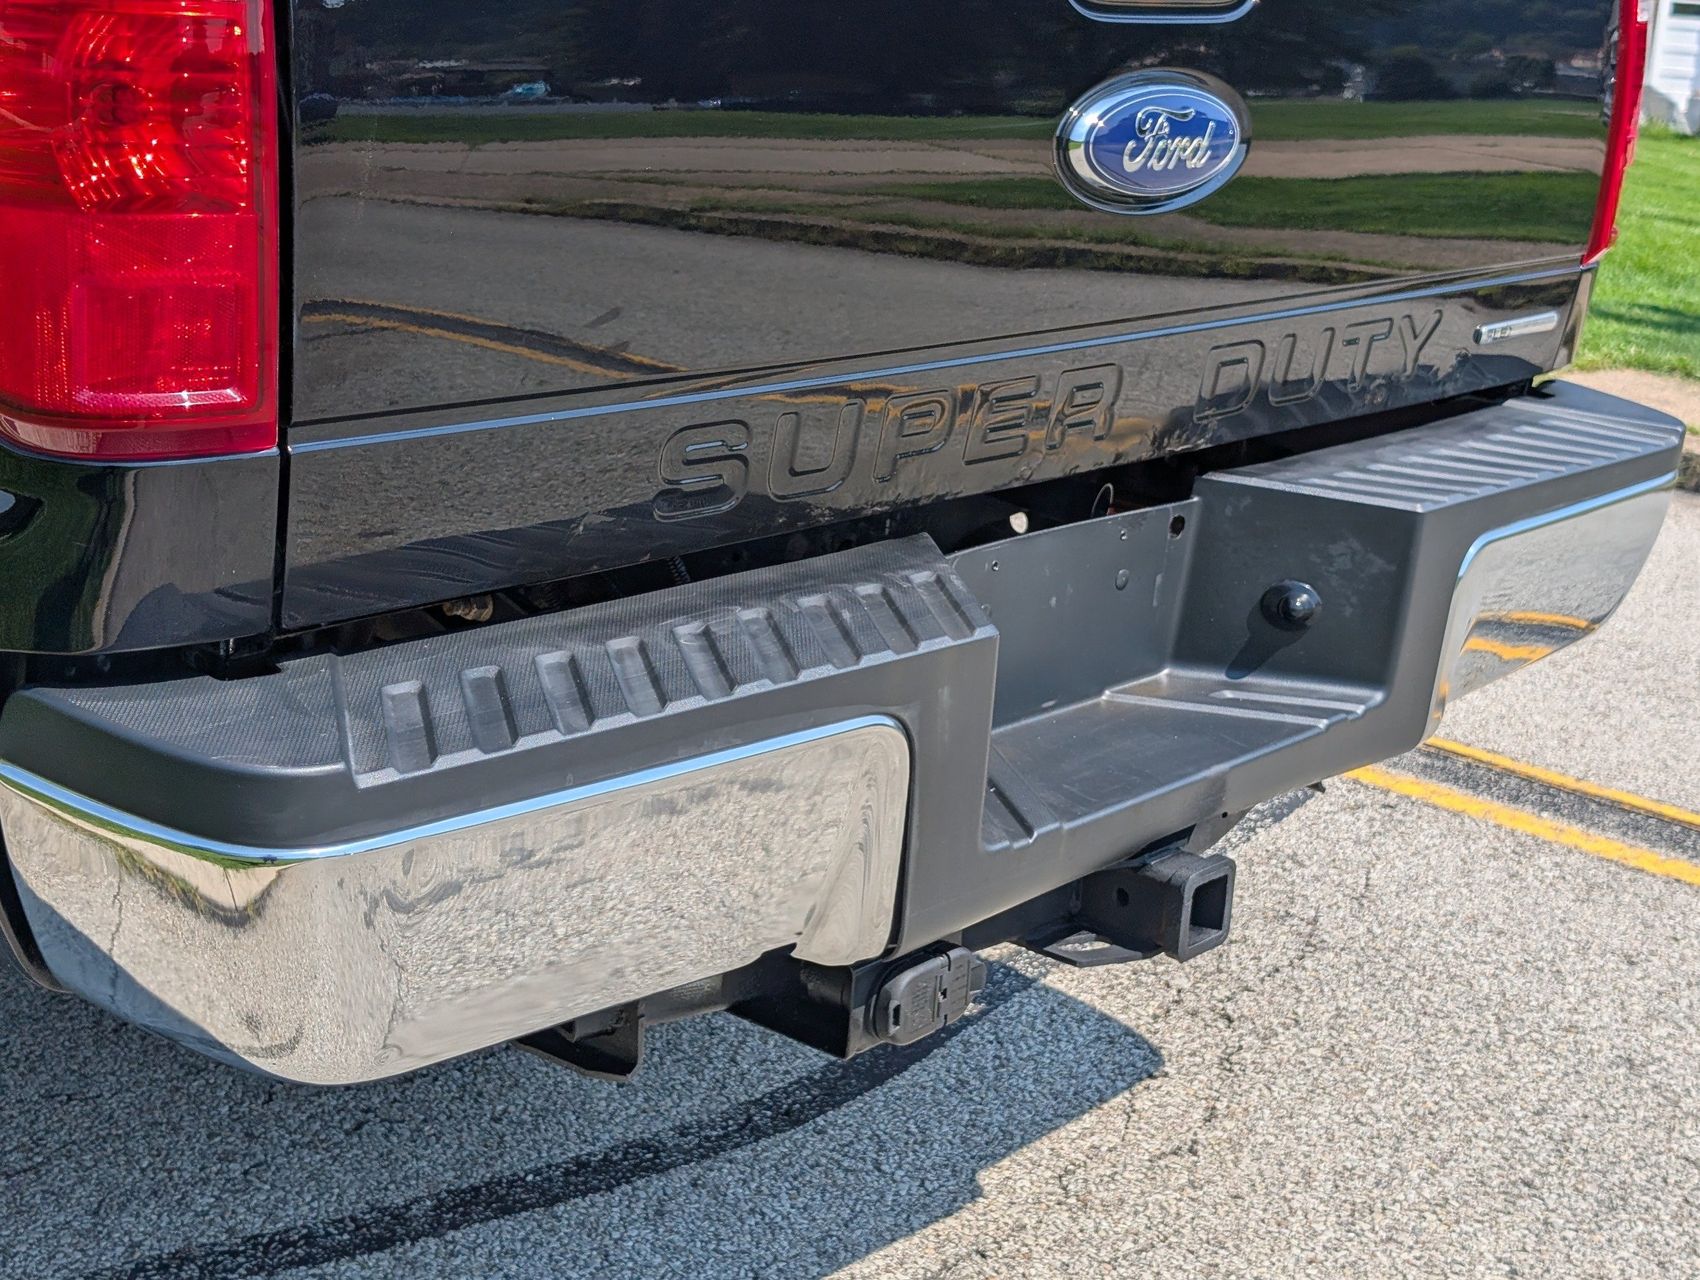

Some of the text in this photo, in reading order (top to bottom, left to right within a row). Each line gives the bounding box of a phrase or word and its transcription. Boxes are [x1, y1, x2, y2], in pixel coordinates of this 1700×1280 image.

[1123, 106, 1216, 173] Ford
[652, 308, 1444, 523] SUPER DUTY
